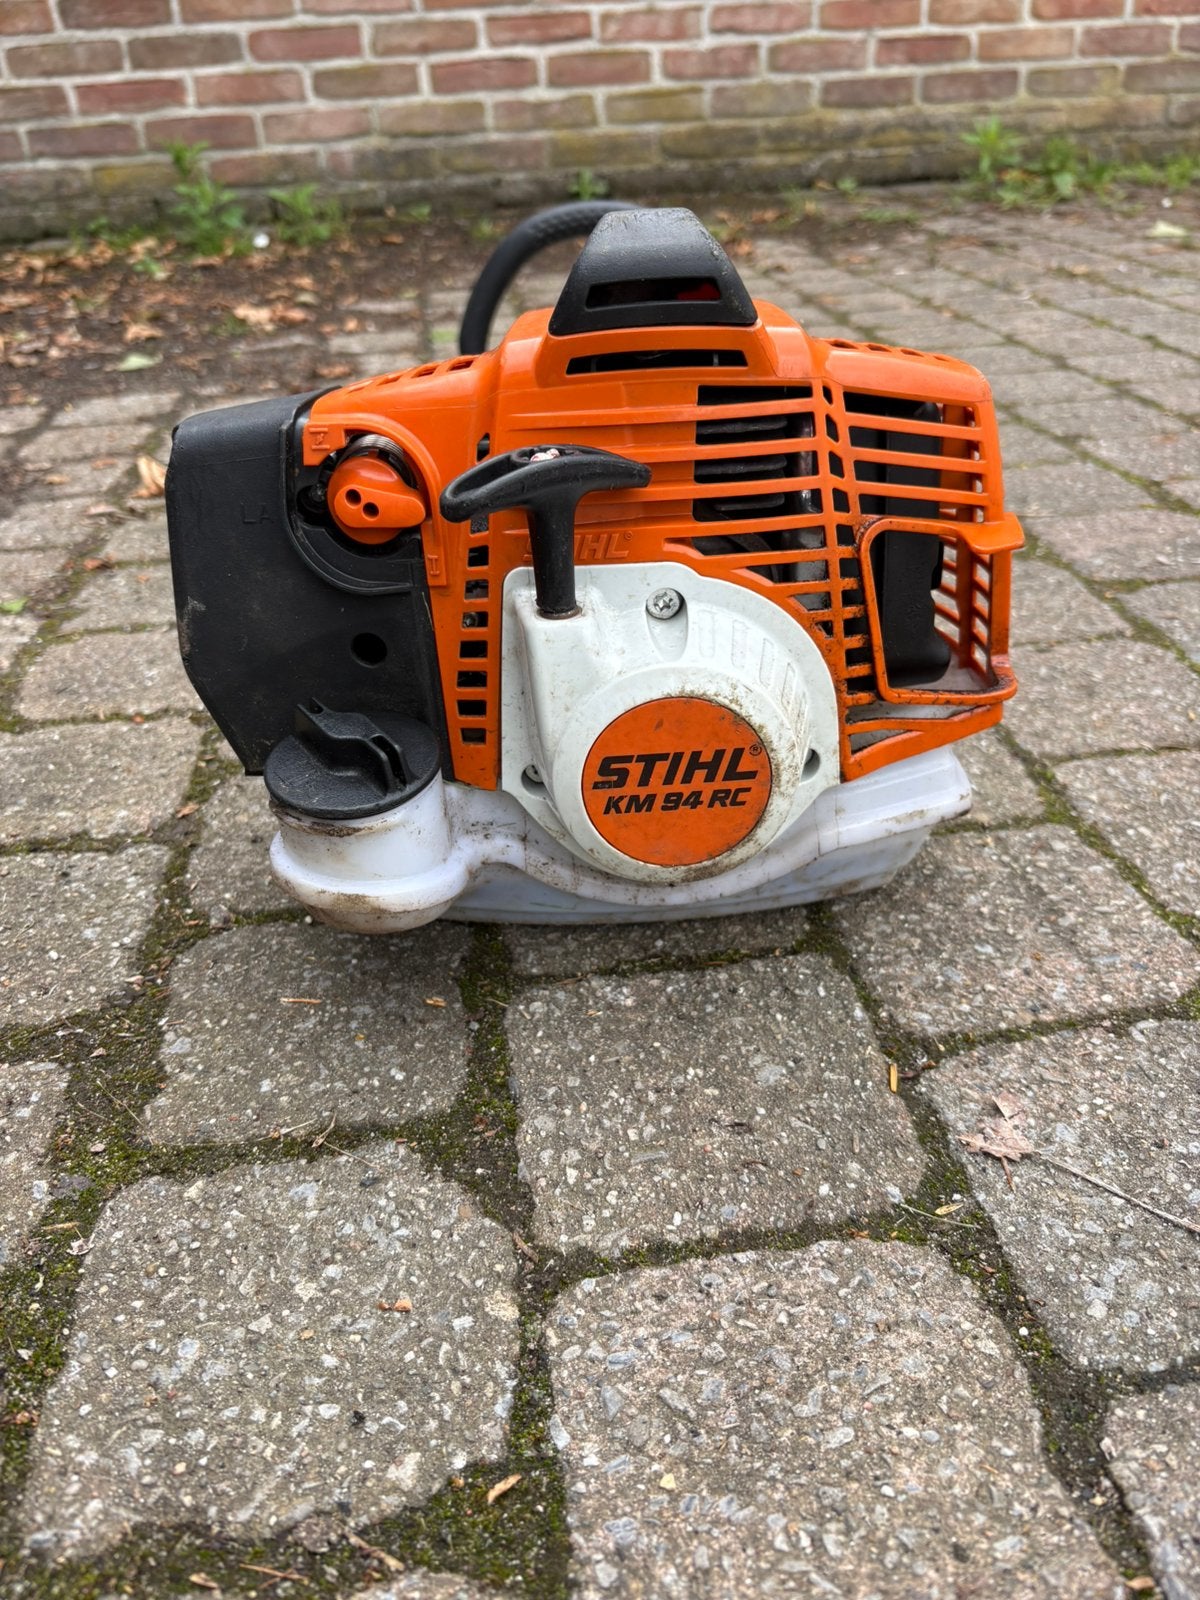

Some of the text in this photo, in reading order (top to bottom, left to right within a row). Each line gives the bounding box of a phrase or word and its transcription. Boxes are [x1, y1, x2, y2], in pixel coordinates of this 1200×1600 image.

[602, 787, 752, 815] KM 94 RC
